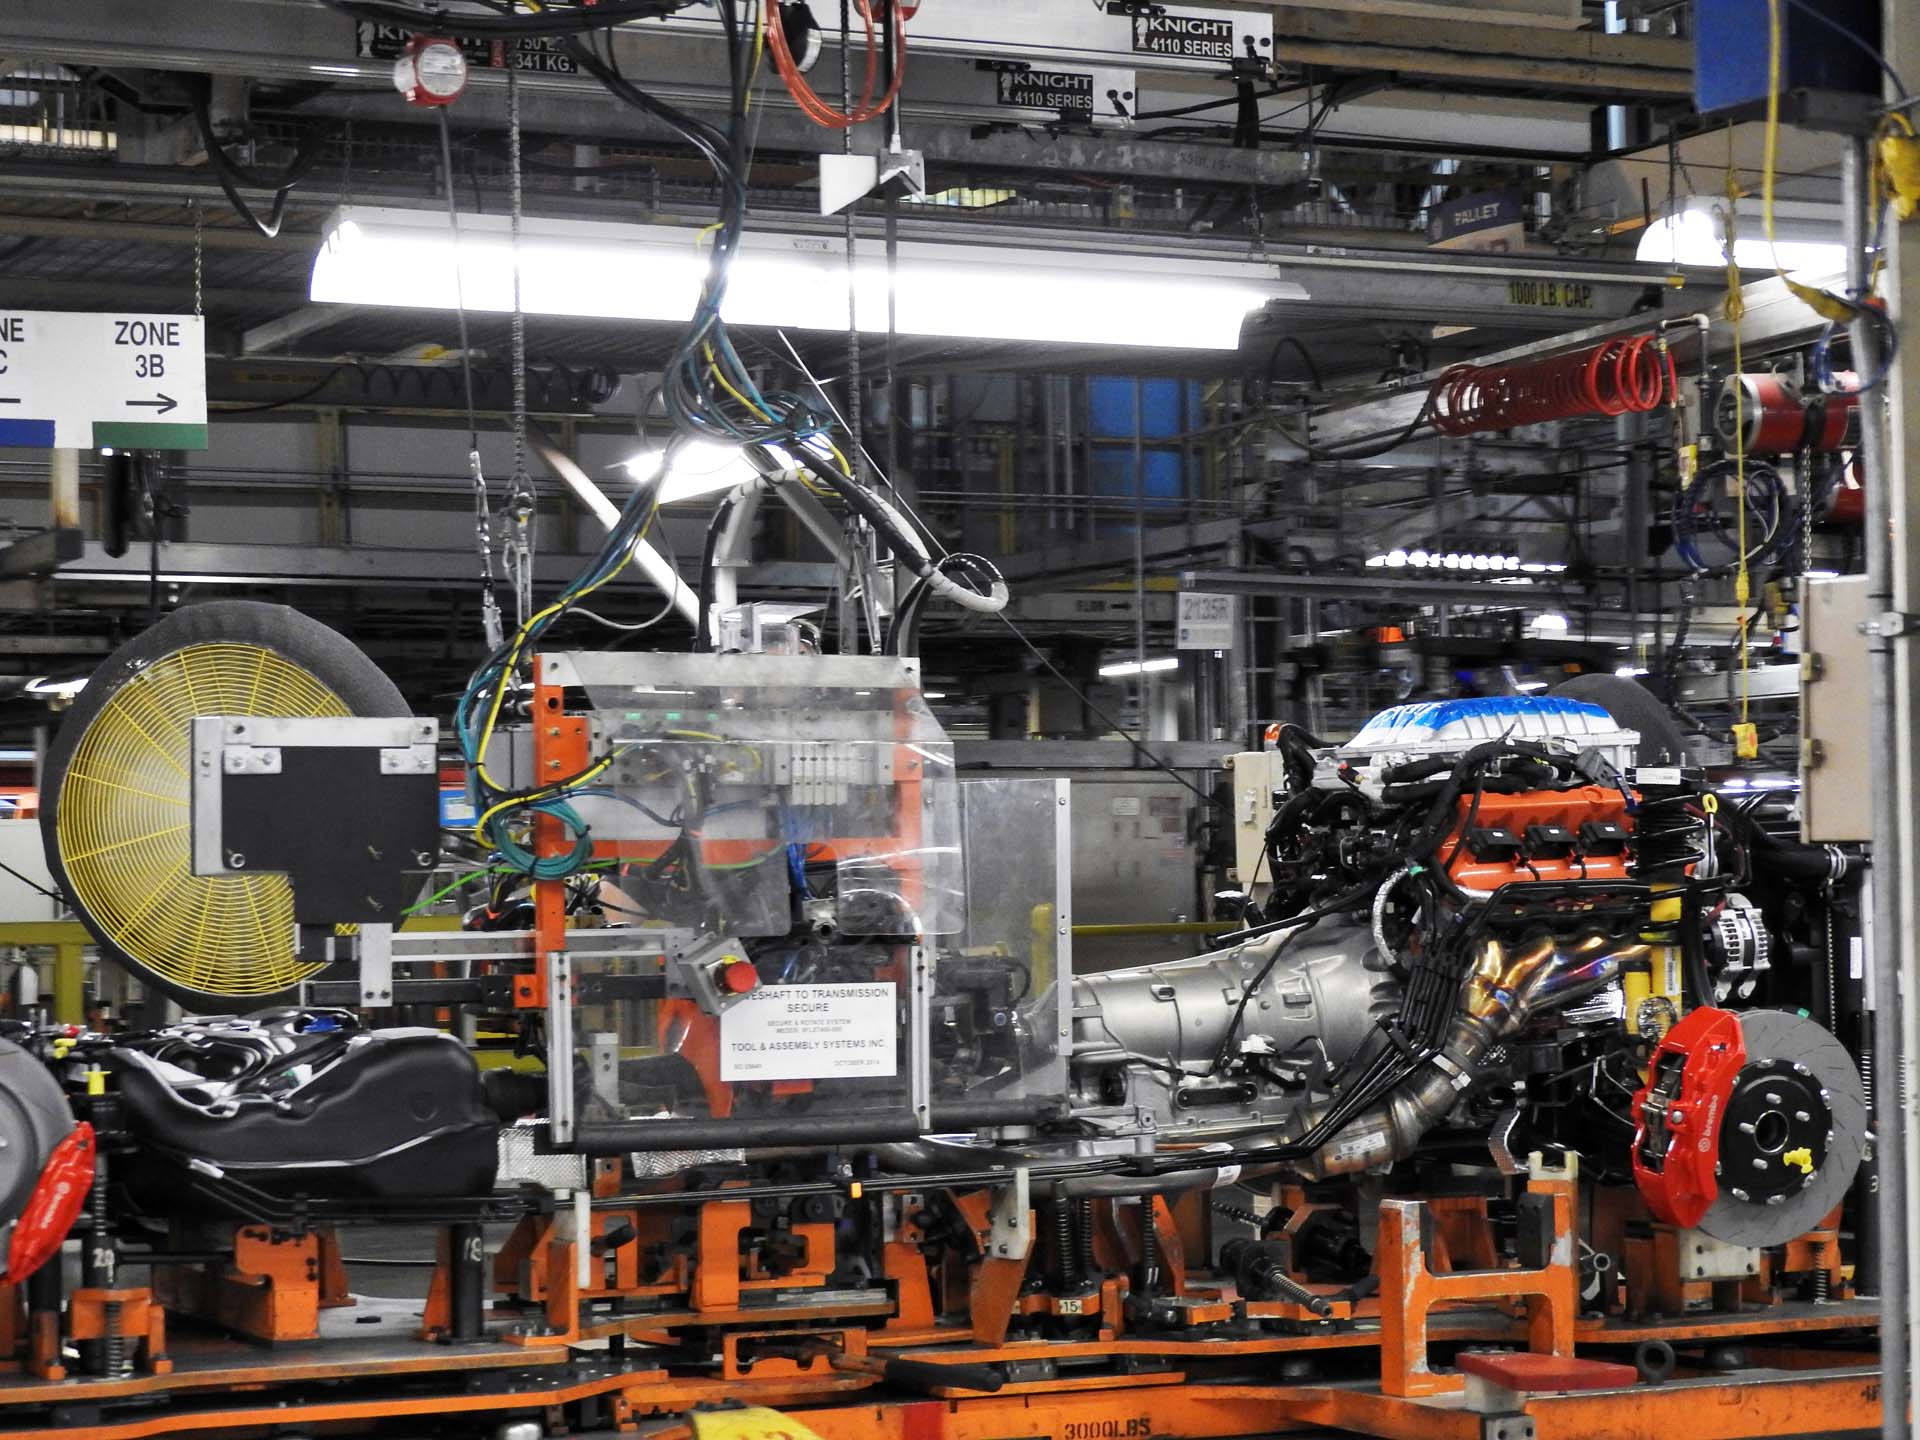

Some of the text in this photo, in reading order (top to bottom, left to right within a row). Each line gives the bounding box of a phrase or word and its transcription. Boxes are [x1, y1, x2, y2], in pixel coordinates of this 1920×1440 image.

[1150, 18, 1232, 36] KNIGHT
[1151, 38, 1232, 57] 4110 SERIES
[515, 53, 541, 70] 341
[547, 55, 575, 72] KG.
[1014, 72, 1092, 89] KNIGHT
[1015, 91, 1092, 109] 4110 SERIES
[1454, 203, 1501, 226] PALLET
[1510, 281, 1538, 304] 1000
[115, 321, 180, 346] ZONE
[136, 354, 165, 378] 3B
[795, 991, 809, 1000] TO
[812, 988, 889, 999] TRANSMISSION
[787, 1003, 830, 1013] SECURE
[731, 1042, 758, 1052] TOOL
[760, 1042, 767, 1051] &
[769, 1041, 820, 1050] ASSEMBLY
[823, 1039, 866, 1049] SYSTEMS
[1064, 1417, 1152, 1440] 3000LBS
